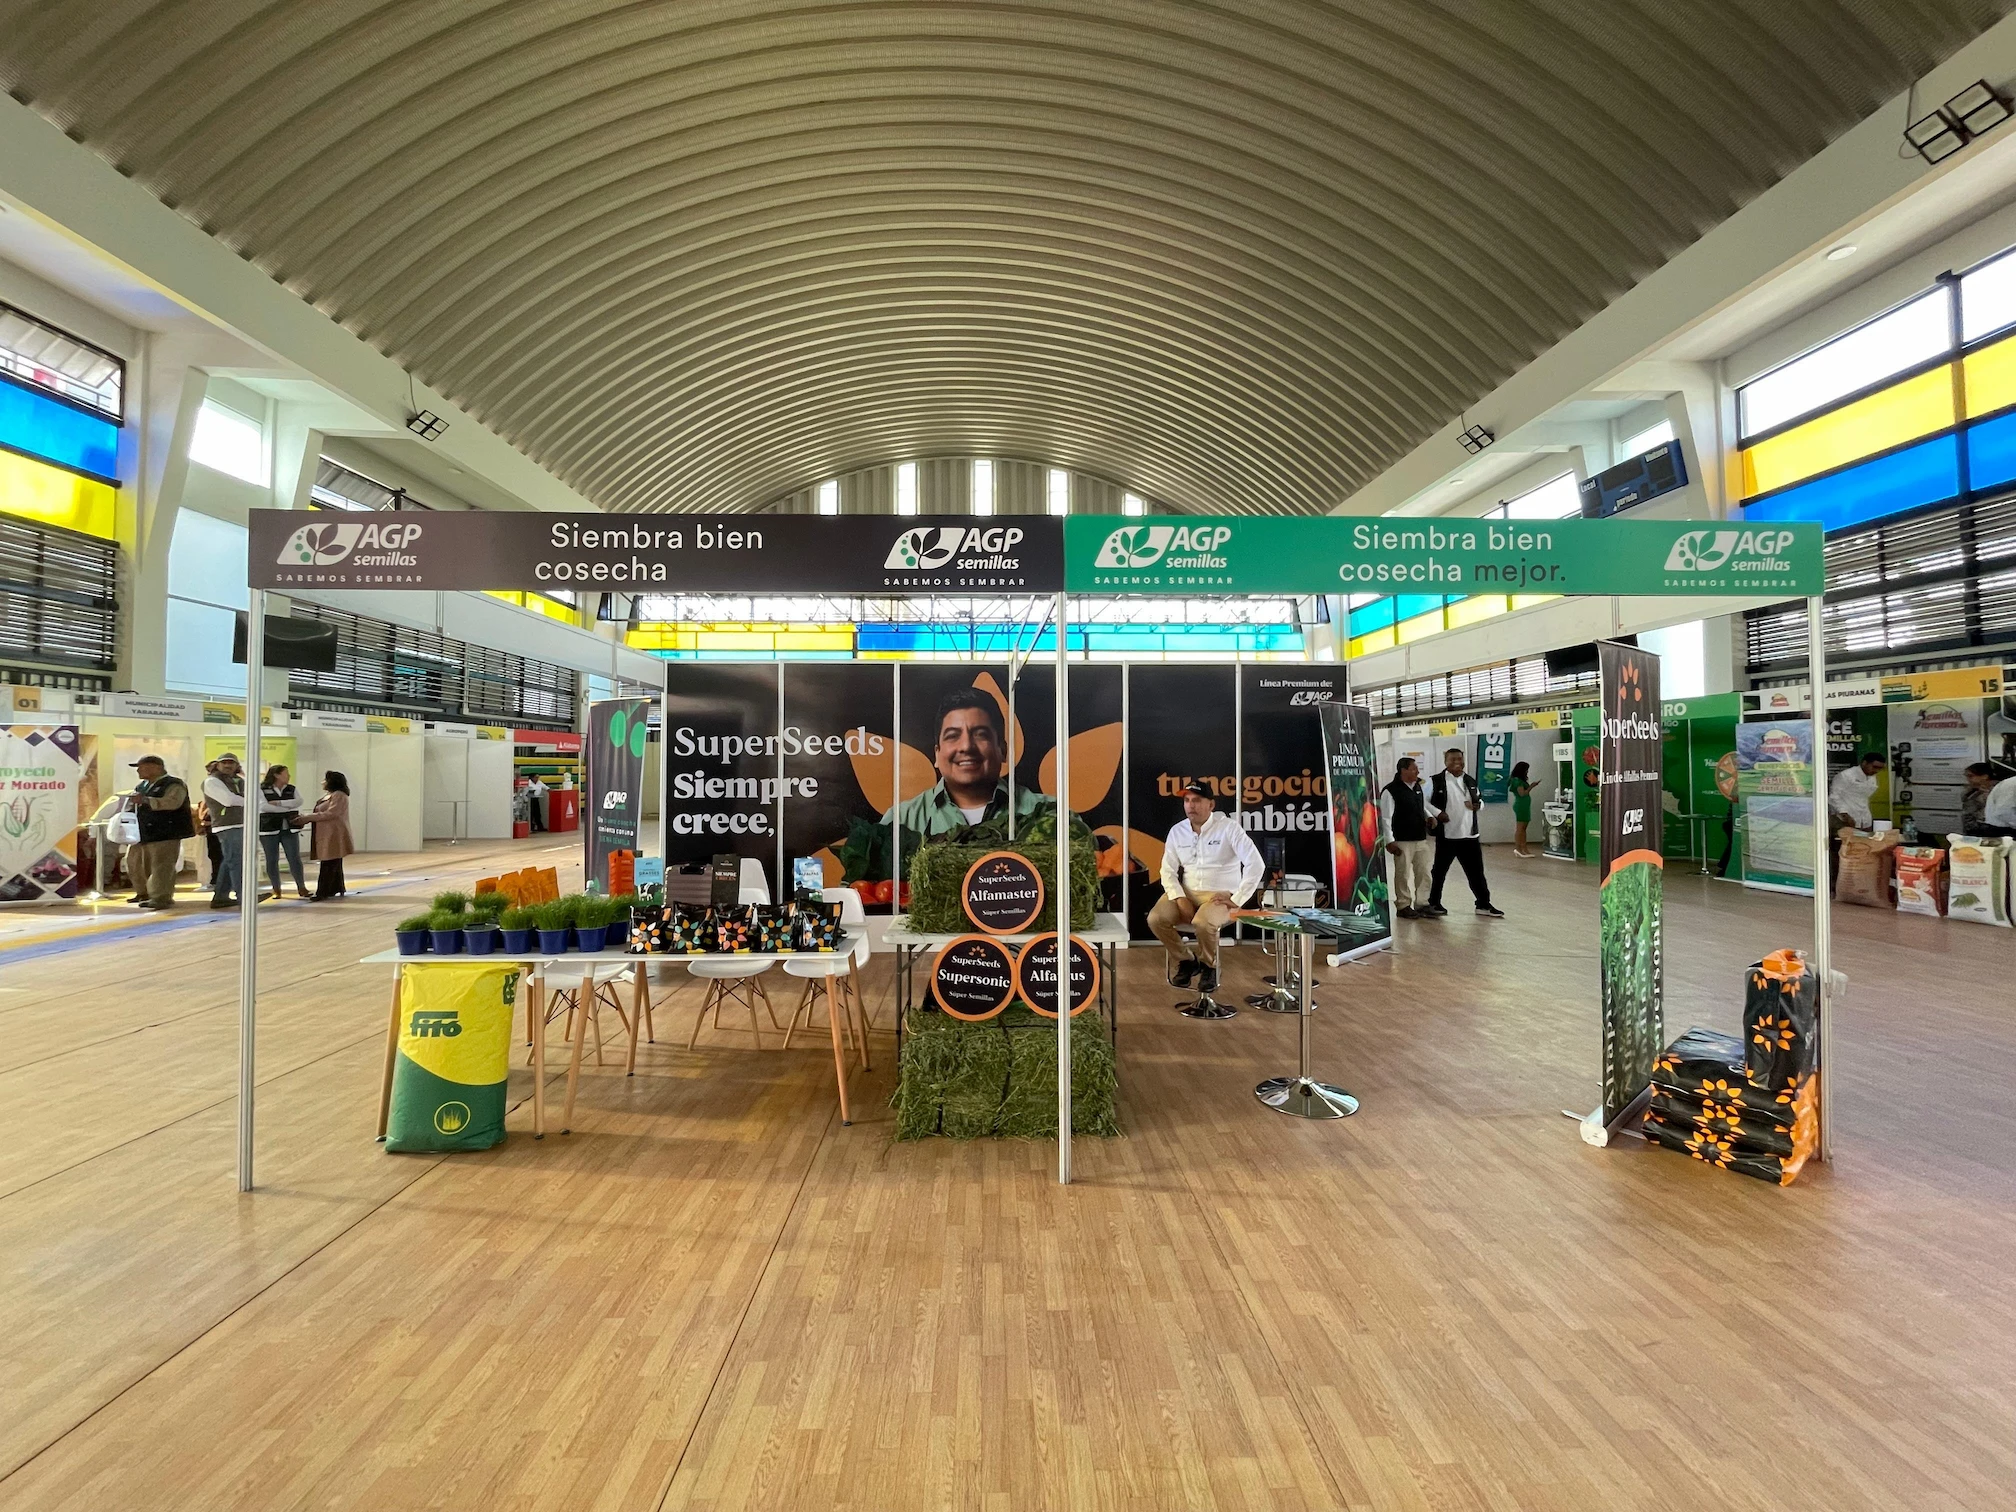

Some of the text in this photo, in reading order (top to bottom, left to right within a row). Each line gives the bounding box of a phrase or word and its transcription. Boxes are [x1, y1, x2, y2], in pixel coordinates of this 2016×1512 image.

[357, 523, 423, 549] AGP
[551, 522, 764, 549] Siembra bien
[960, 527, 1024, 553] AGP
[1170, 526, 1232, 551] AGP
[1353, 524, 1553, 551] Siembra bien
[1734, 531, 1794, 555] AGP
[353, 551, 418, 567] semillas
[956, 555, 1020, 570] semillas
[1166, 553, 1228, 568] semillas
[1731, 556, 1791, 572] semillas
[534, 556, 668, 581] cosecha
[1338, 557, 1567, 588] cosecha mejor.
[276, 574, 423, 583] SABEMOS SEMBRAR
[883, 577, 1026, 586] SABEMOS SEMBRAR
[1094, 576, 1233, 585] SABEMOS SEMBRAR
[1664, 579, 1797, 588] SABEMOS SEMBRAR
[1282, 679, 1319, 688] Premium
[1979, 679, 1999, 693] 15
[1313, 691, 1333, 701] AGP
[1837, 688, 1875, 698] PIURANAS
[18, 698, 38, 708] 01
[125, 700, 186, 709] MUNICIPALIDAD
[1661, 702, 1687, 717] RO
[673, 726, 884, 765] SuperSeeds
[1826, 735, 1862, 743] EMILLAS
[0, 767, 56, 778] royecto
[11, 781, 66, 790] Morado
[673, 769, 819, 804] Siempre
[1199, 768, 1327, 805] negocio
[1213, 801, 1330, 832] mbién
[672, 812, 775, 837] crece,
[978, 873, 1027, 885] SuperSeeds
[969, 888, 1038, 902] Alfamaster
[951, 955, 1001, 968] SuperSeeds
[937, 968, 1010, 989] Supersonic
[1030, 969, 1086, 982] Alfaus
[1651, 902, 1662, 1056] upersonic
